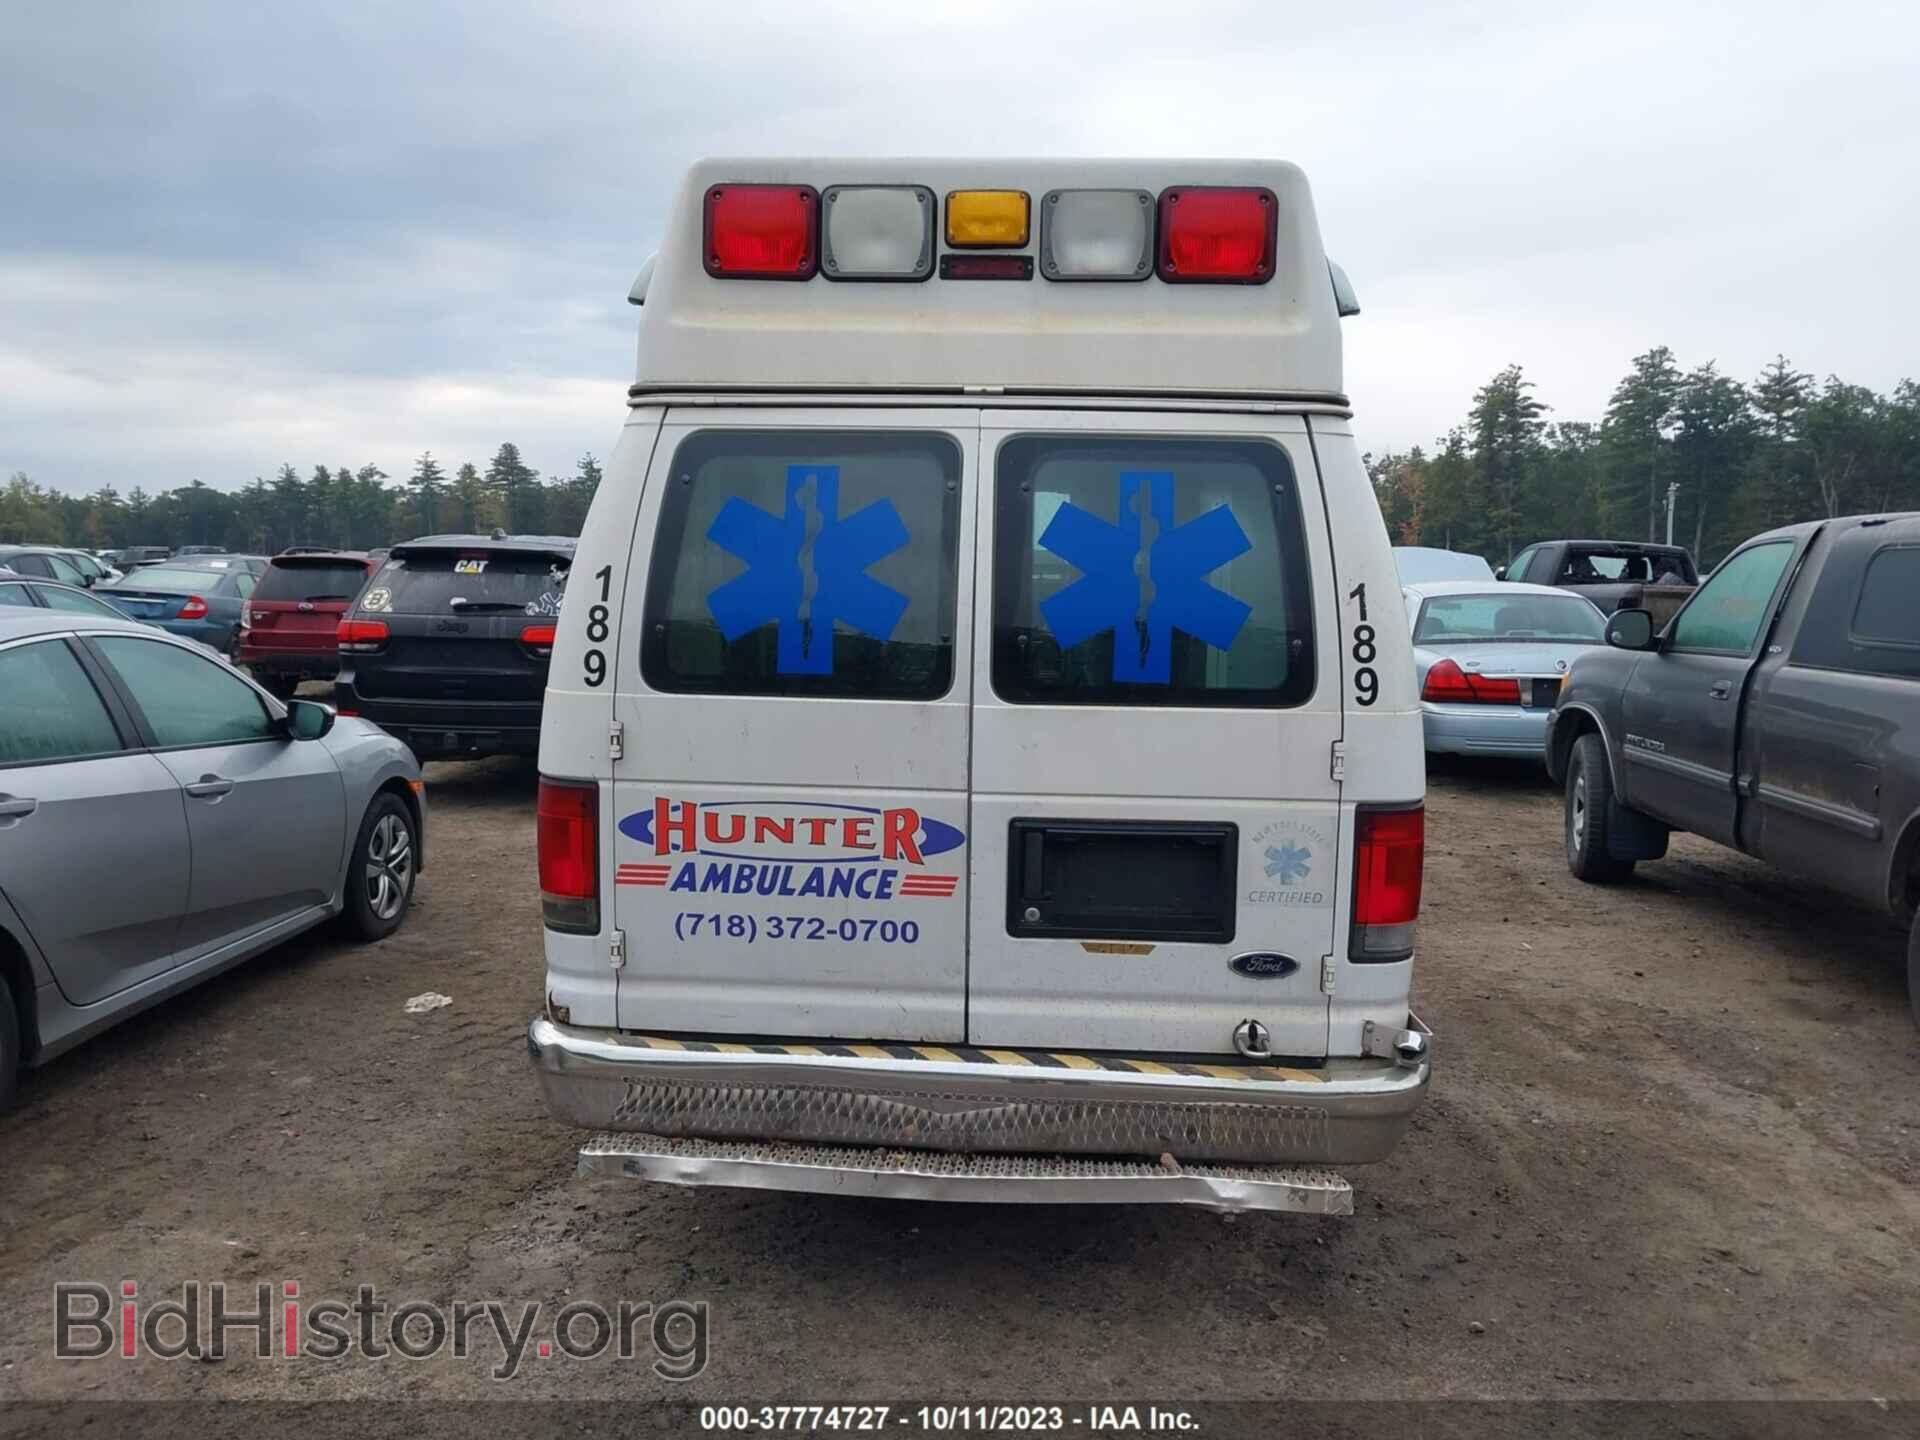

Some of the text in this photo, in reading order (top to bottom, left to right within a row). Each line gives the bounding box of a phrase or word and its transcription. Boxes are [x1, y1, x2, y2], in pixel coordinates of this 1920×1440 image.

[454, 560, 488, 573] CAT
[584, 565, 612, 687] 189
[1349, 583, 1379, 706] 189
[655, 797, 925, 866] HUNTER
[669, 862, 898, 900] AMBULANCE
[1248, 890, 1323, 904] CERTIFIED
[674, 912, 920, 943] (718) 372-0700
[1246, 956, 1283, 973] Ford
